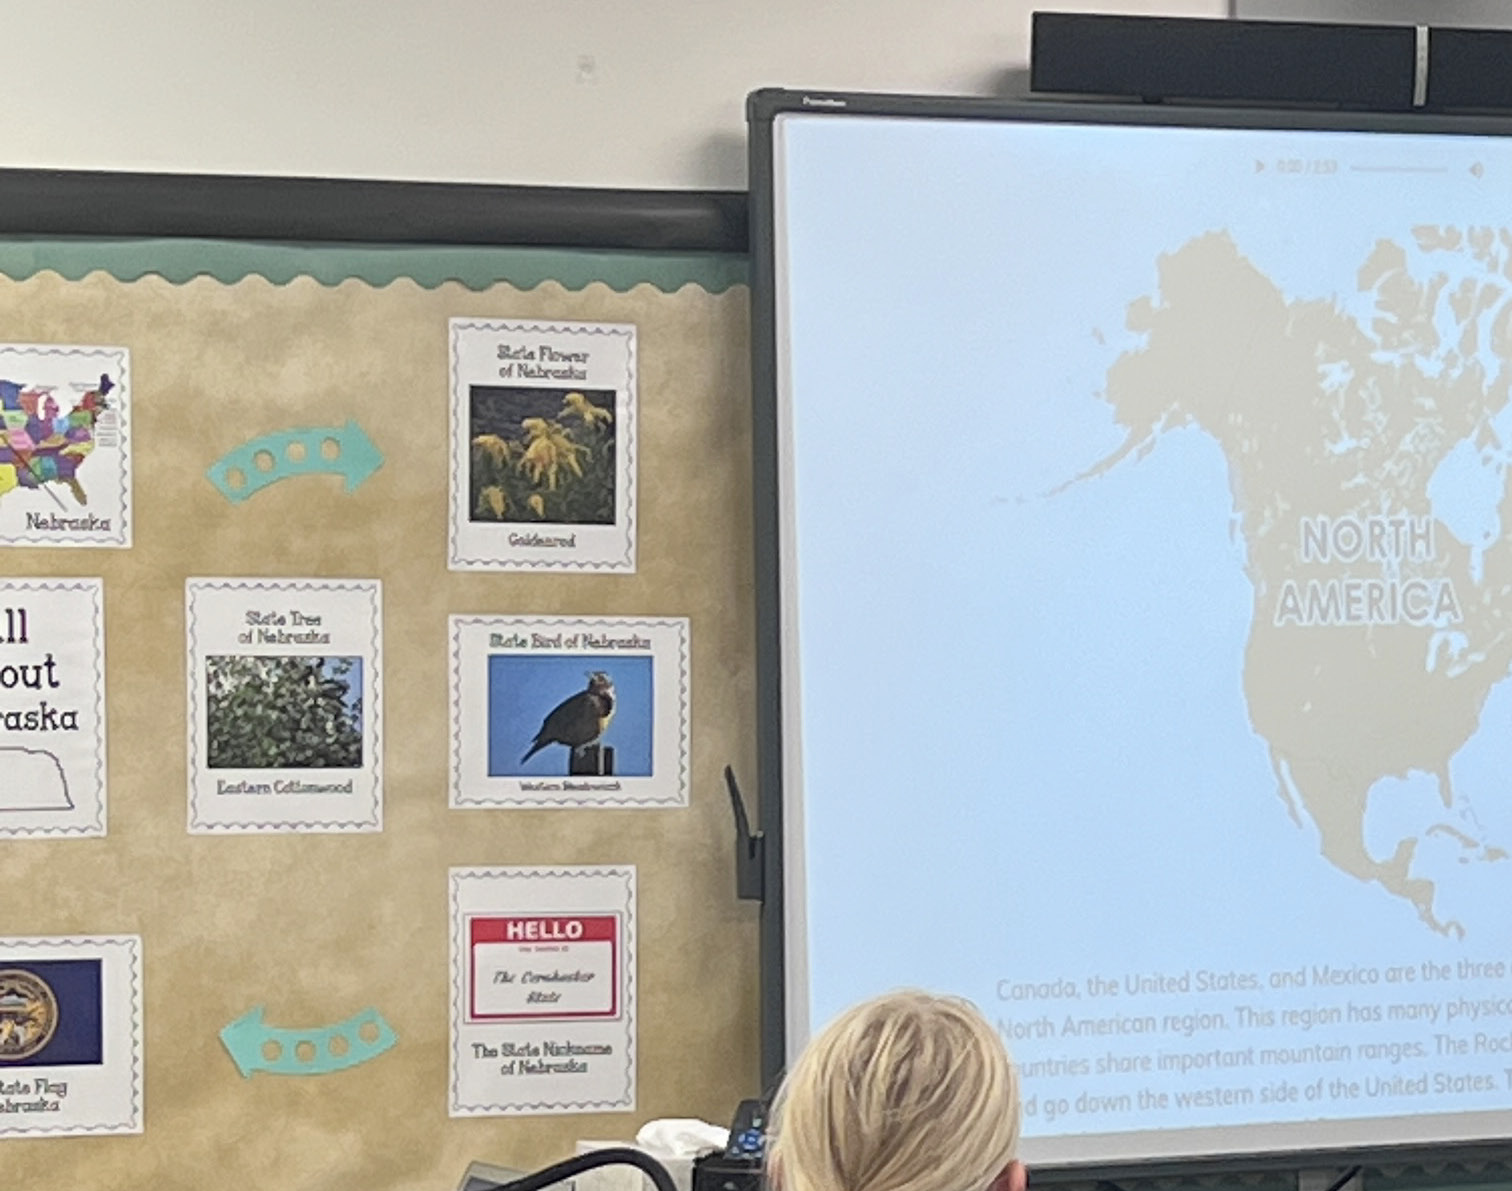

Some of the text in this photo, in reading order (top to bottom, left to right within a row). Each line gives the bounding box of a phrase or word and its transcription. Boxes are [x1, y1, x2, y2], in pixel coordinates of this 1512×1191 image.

[498, 363, 587, 380] of Nebraska
[26, 512, 112, 532] Nebraska
[1302, 517, 1434, 560] NORTH
[1275, 580, 1463, 624] AMERICA
[0, 608, 28, 644] ll
[238, 628, 330, 645] of Nebraska
[581, 633, 652, 650] Nebraska
[0, 700, 79, 732] aska
[506, 921, 584, 940] HELLO
[996, 976, 1081, 1002] Canada,
[1086, 974, 1119, 997] the
[1124, 970, 1190, 996] United
[1195, 969, 1264, 993] States,
[1269, 964, 1306, 989] and
[1312, 963, 1379, 986] Mexico
[1384, 964, 1416, 983] are
[1422, 958, 1451, 982] the
[1457, 957, 1505, 980] three
[998, 1015, 1055, 1040] North
[1061, 1012, 1157, 1038] American
[1162, 1008, 1230, 1037] region.
[1233, 1005, 1275, 1029] This
[1282, 1002, 1342, 1032] region
[1347, 1000, 1382, 1023] has
[1388, 1002, 1441, 1025] many
[471, 1043, 497, 1059] The
[501, 1042, 540, 1058] State
[1095, 1052, 1152, 1075] share
[1157, 1046, 1255, 1074] important
[1260, 1042, 1352, 1066] mountain
[1358, 1041, 1429, 1065] ranges.
[1433, 1033, 1469, 1056] The
[500, 1059, 589, 1075] of Nebraska
[34, 1078, 68, 1099] Flag
[1043, 1096, 1069, 1122] go
[1075, 1091, 1132, 1116] down
[1137, 1087, 1169, 1111] the
[1174, 1084, 1254, 1109] western
[1260, 1079, 1299, 1103] side
[1304, 1077, 1325, 1101] of
[1329, 1077, 1360, 1100] the
[1365, 1072, 1429, 1097] United
[1433, 1070, 1498, 1094] States.
